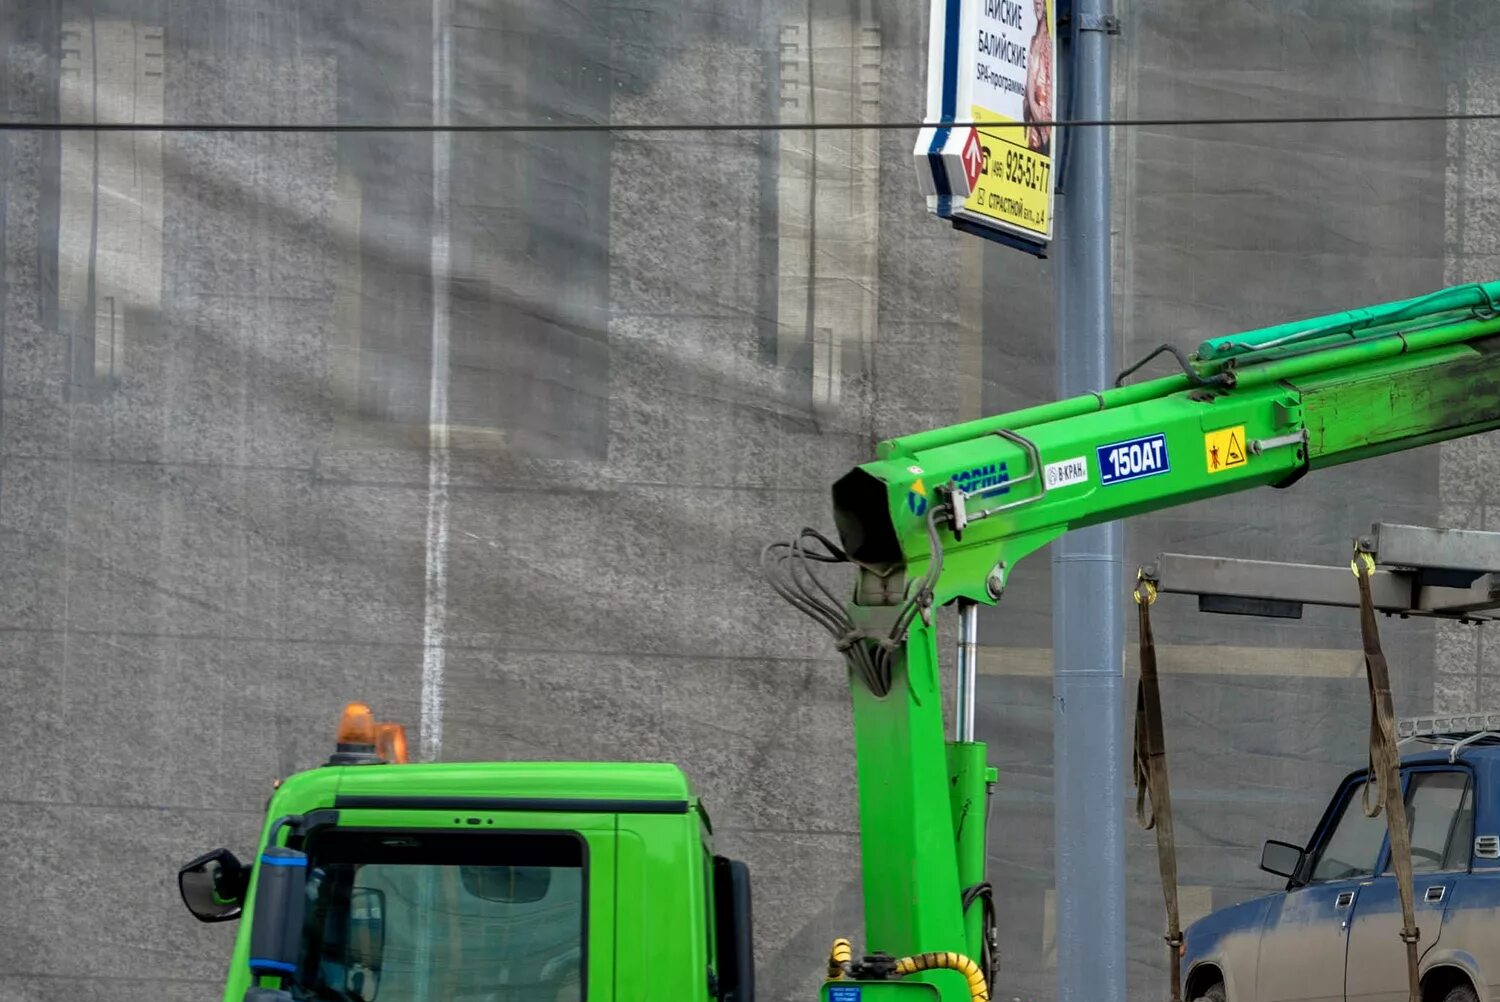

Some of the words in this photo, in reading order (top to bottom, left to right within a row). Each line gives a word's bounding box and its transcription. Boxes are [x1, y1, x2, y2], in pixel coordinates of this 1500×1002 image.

[979, 30, 1026, 69] БАЛИЙСКИЕ
[1006, 149, 1050, 194] 925-51-77
[988, 192, 1023, 217] СТРАСТНОЙ
